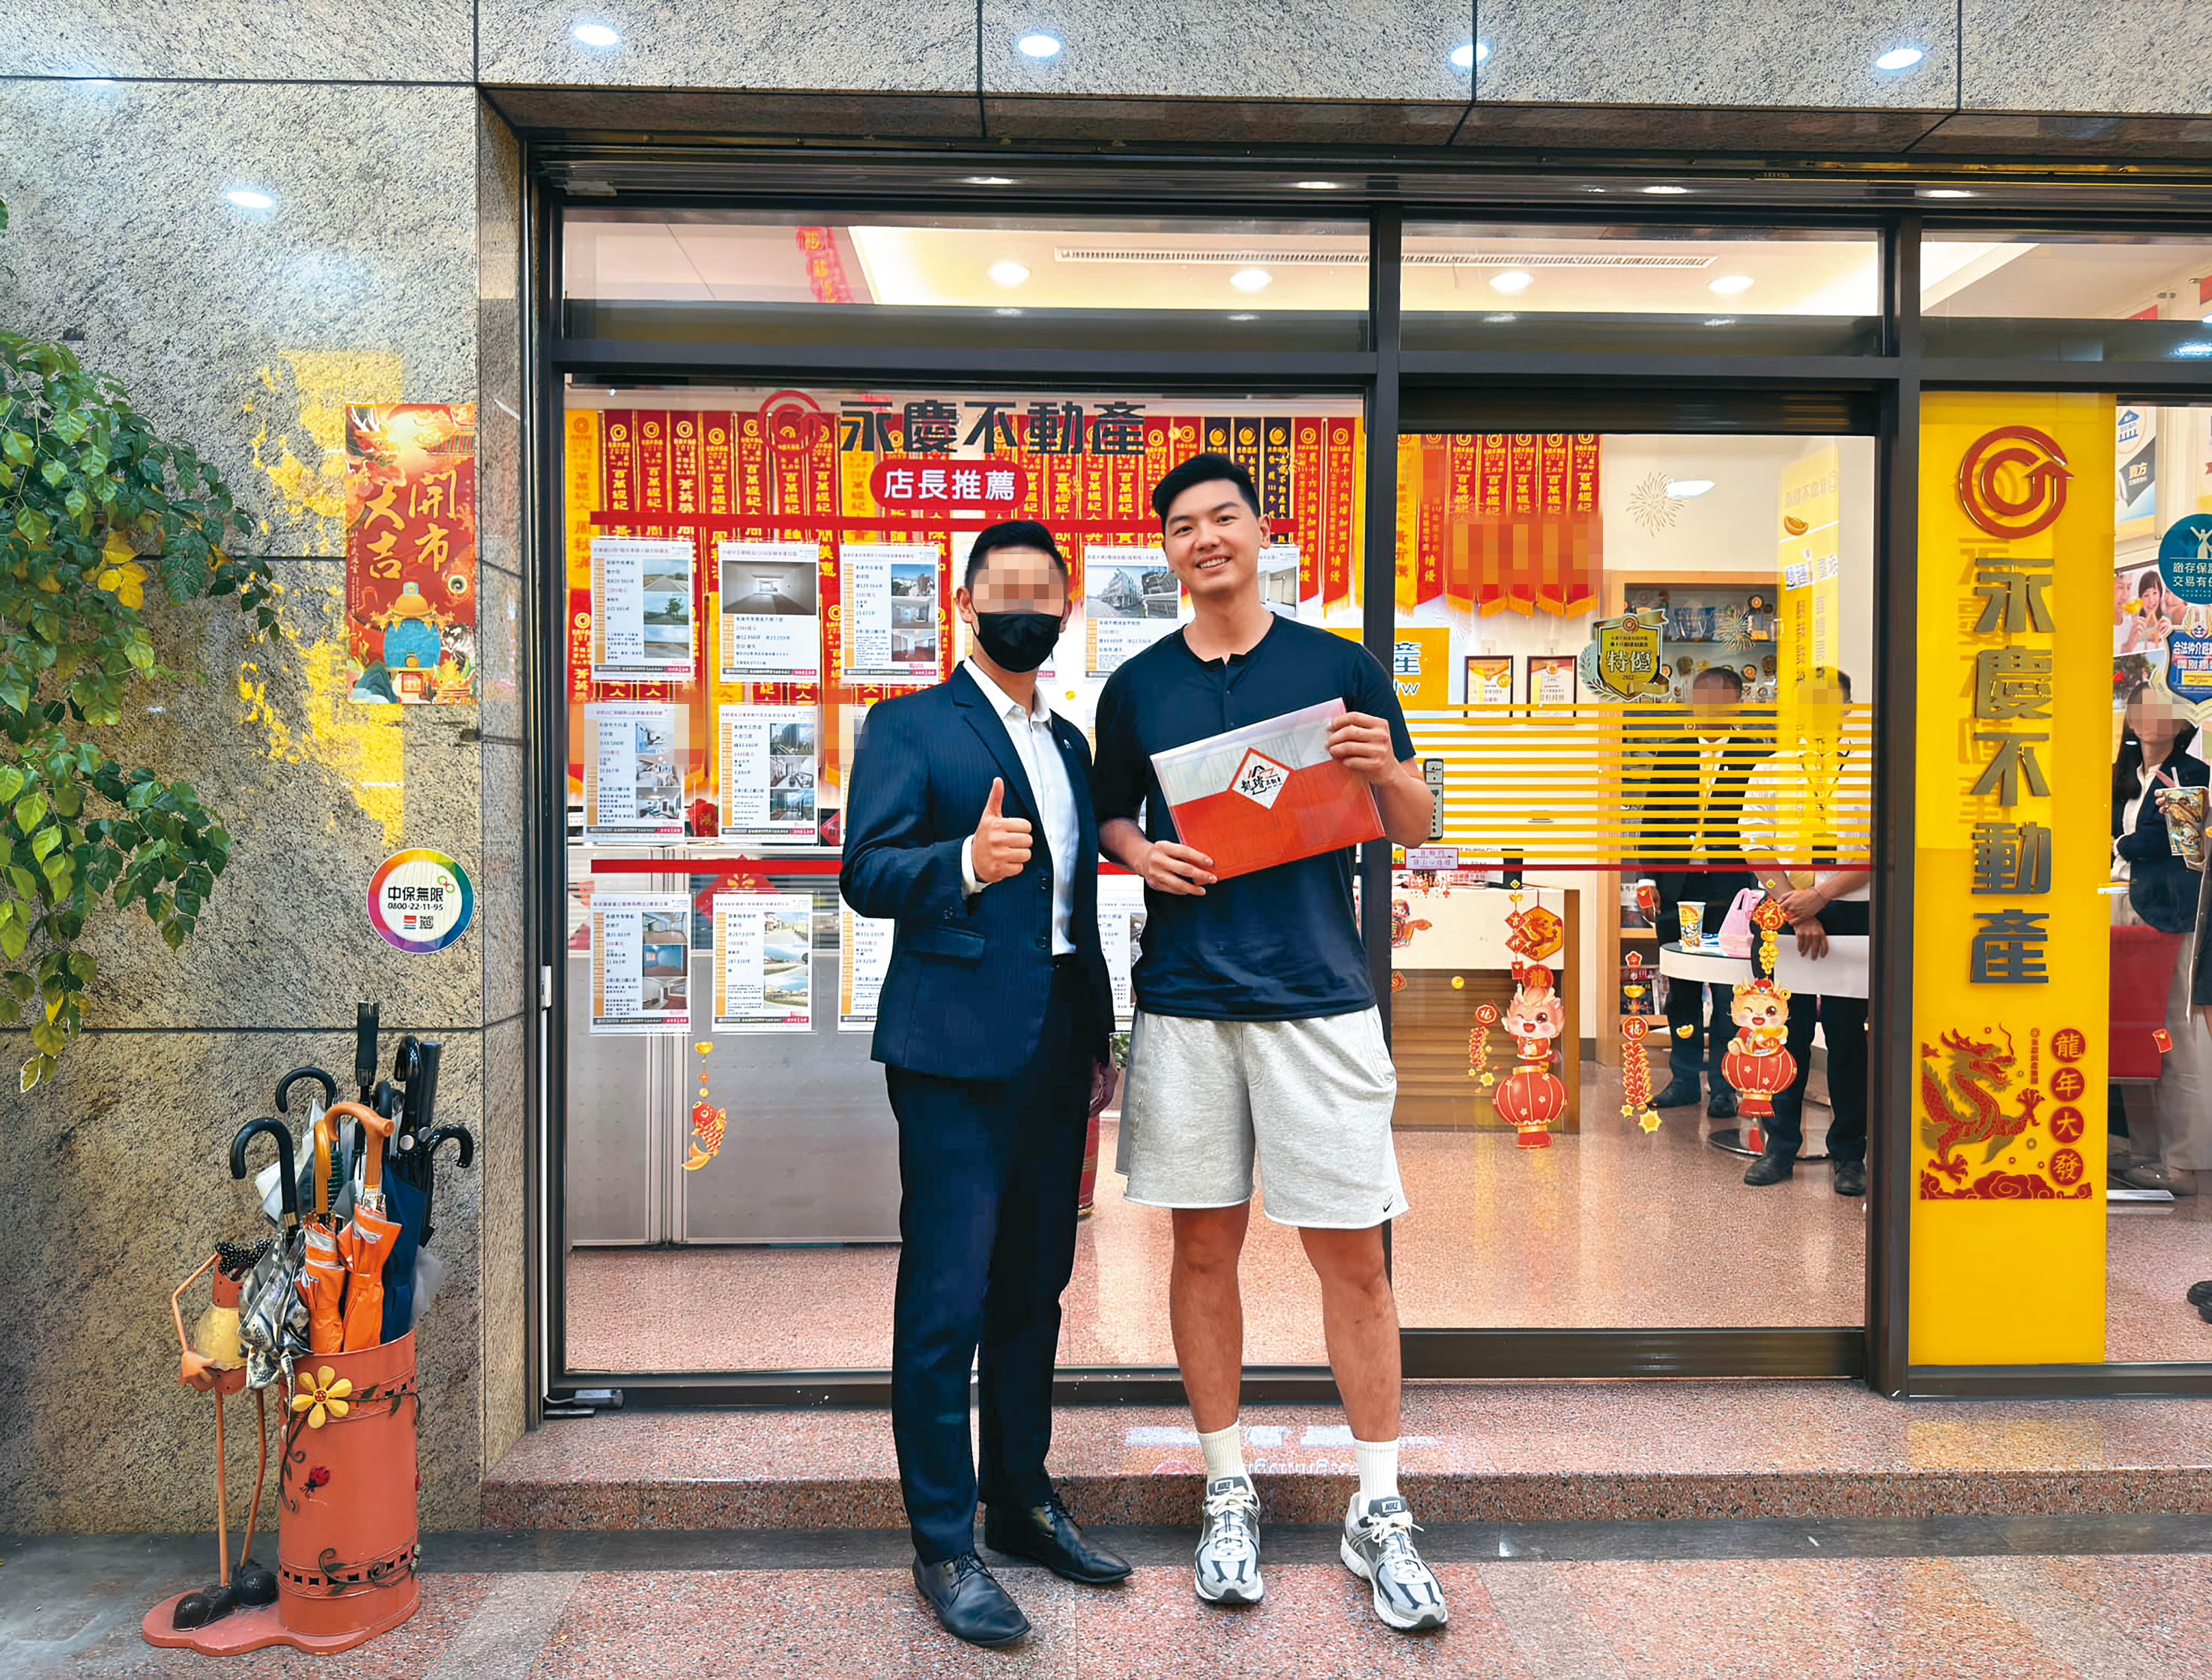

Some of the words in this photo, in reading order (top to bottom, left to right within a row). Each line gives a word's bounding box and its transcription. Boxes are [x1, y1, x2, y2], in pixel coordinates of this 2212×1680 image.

[840, 399, 1146, 455] 永慶不動產
[885, 468, 1015, 500] 店長推薦
[364, 483, 405, 579] 大吉
[408, 469, 458, 572] 開市
[1394, 641, 1422, 676] 產
[1969, 557, 2056, 984] 永慶不動產
[388, 886, 443, 902] 中保無限
[1627, 1020, 1643, 1037] 福
[2053, 1032, 2083, 1181] 龍年大發
[1216, 1482, 1231, 1491] NIKE
[1385, 1502, 1399, 1511] NIKE
